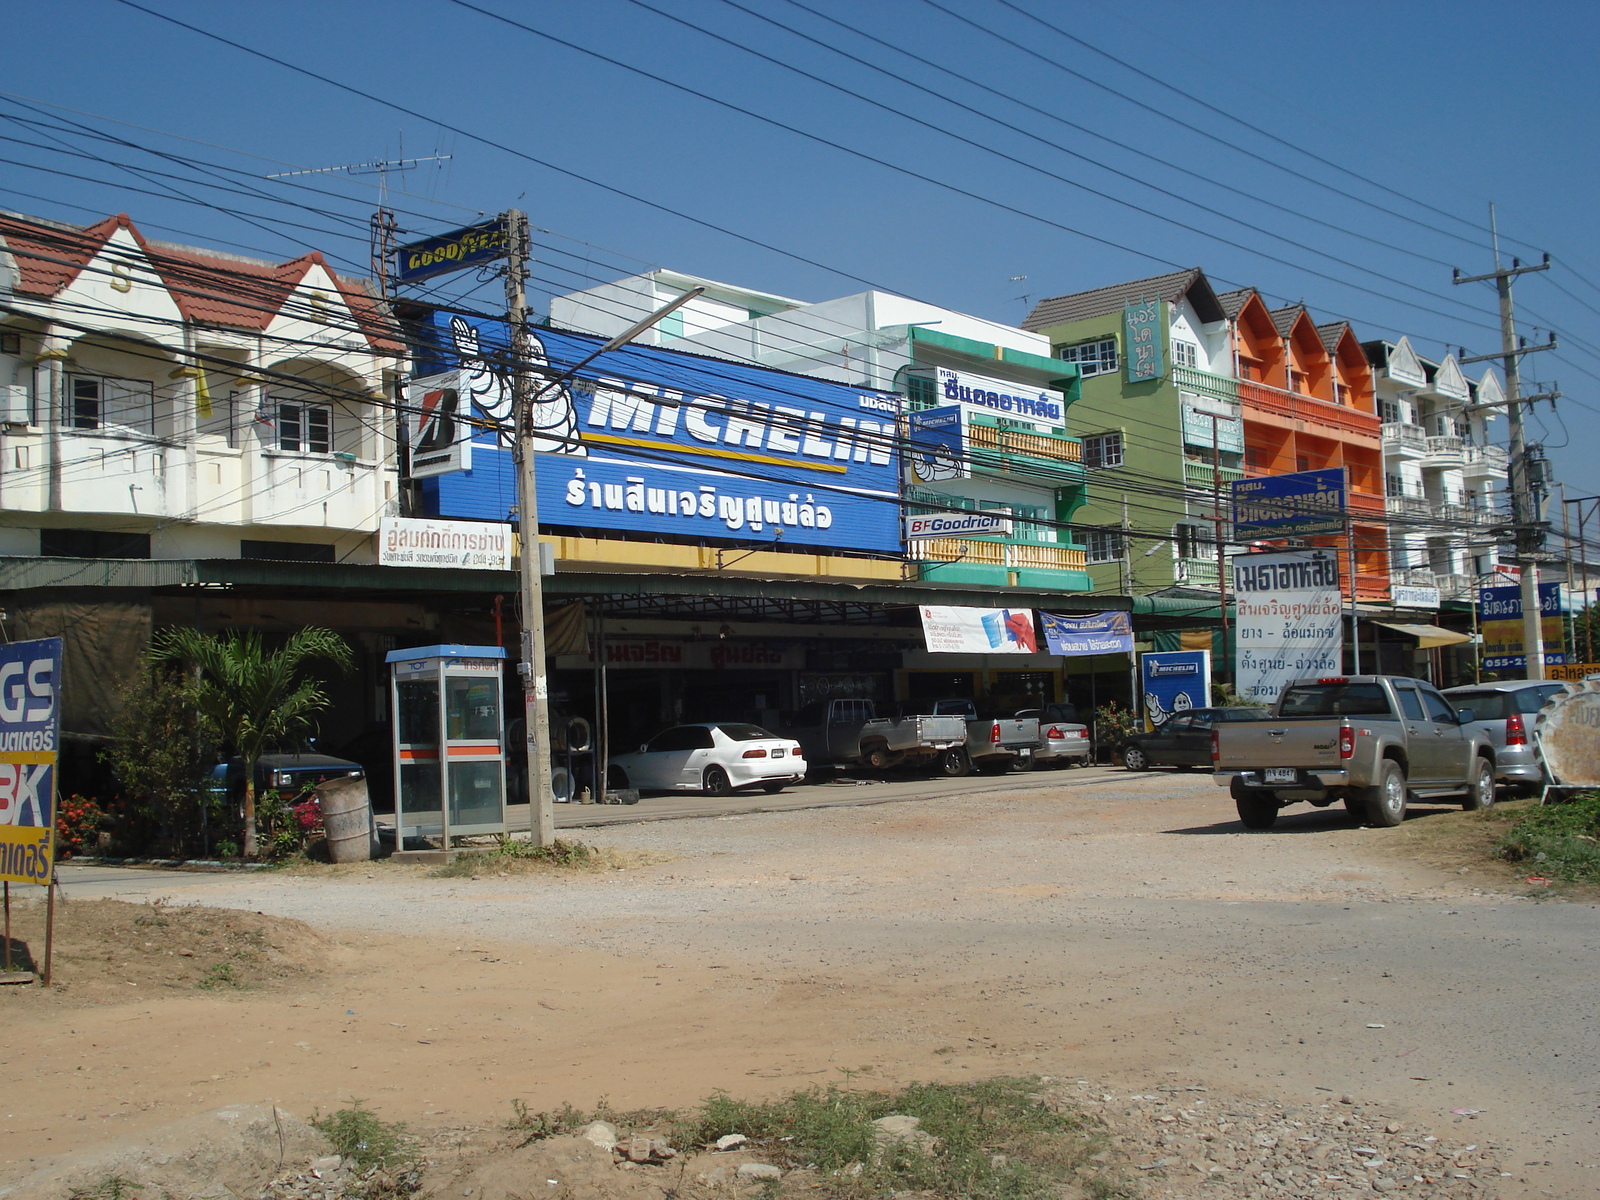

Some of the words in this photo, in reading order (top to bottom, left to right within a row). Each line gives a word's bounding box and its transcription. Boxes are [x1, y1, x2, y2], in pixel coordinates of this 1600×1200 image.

[588, 377, 896, 467] MICHELIN
[911, 515, 1000, 532] BFGoodrich
[1238, 597, 1340, 620] สินเจริญศูนย์ล้อ
[1241, 628, 1263, 639] ยาง
[407, 661, 428, 670] TOT
[0, 658, 54, 722] GS
